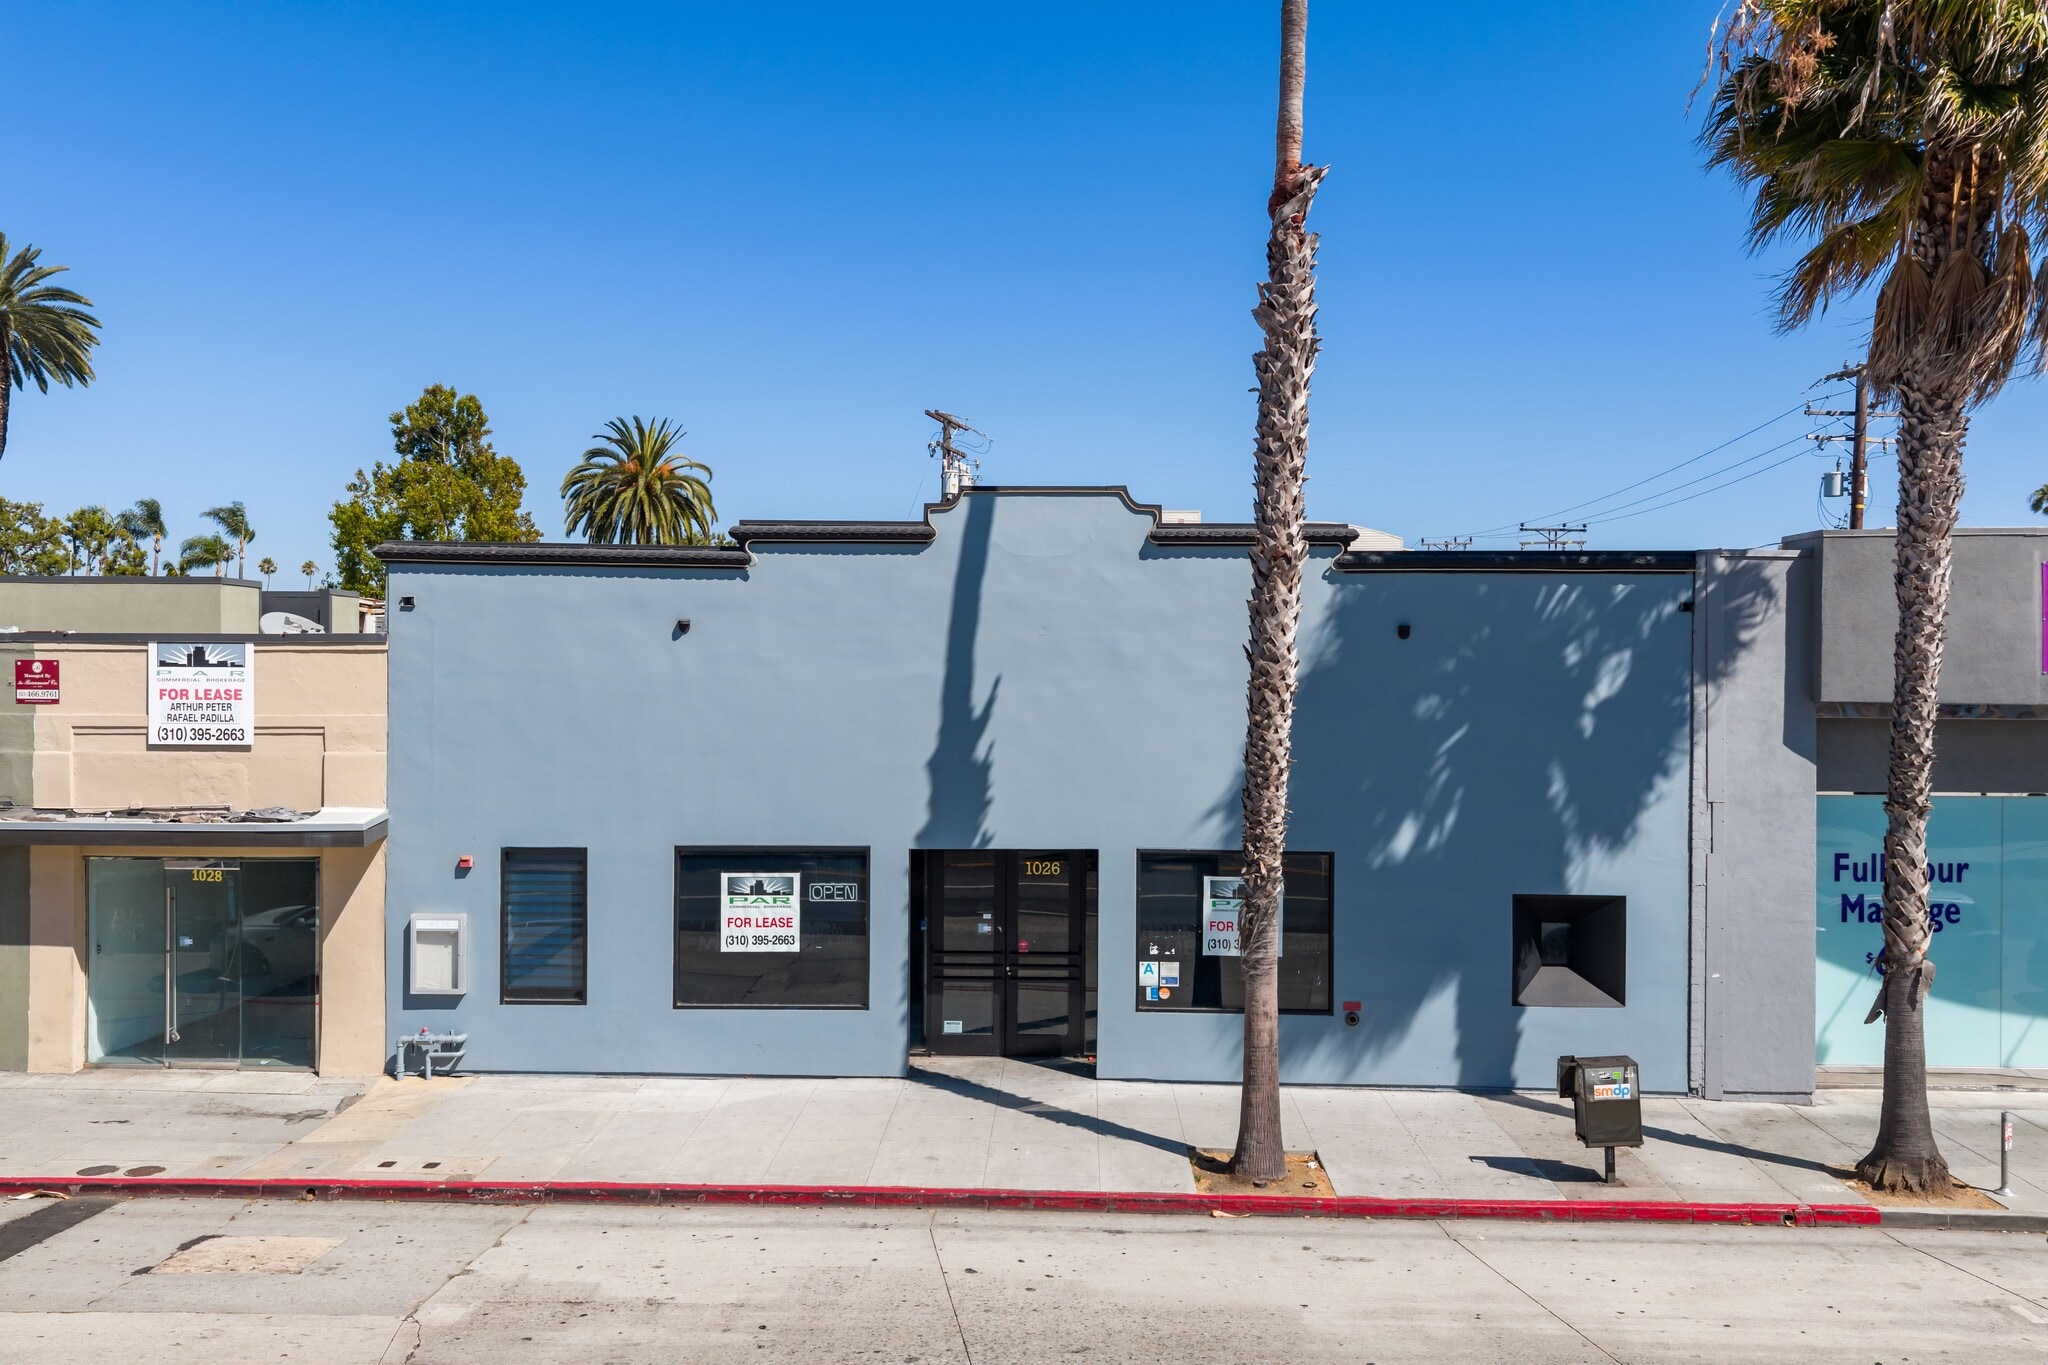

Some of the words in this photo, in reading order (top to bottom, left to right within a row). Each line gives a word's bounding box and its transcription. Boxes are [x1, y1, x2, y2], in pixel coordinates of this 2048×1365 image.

[159, 689, 189, 700] FOR
[195, 689, 242, 700] LEASE
[170, 703, 204, 711] ARTHUR
[206, 703, 232, 711] PETER
[167, 714, 198, 722] RAFAEL
[201, 714, 234, 722] PADILLA
[158, 726, 187, 742] (310)
[190, 728, 244, 741] 395-2663
[1026, 861, 1060, 875] 1026
[192, 869, 223, 882] 1028
[812, 886, 854, 899] OPEN
[728, 917, 752, 928] FOR
[755, 917, 793, 928] LEASE
[1209, 921, 1234, 931] FOR
[725, 935, 748, 948] (310)
[752, 935, 795, 945] 395-2663
[1208, 939, 1231, 951] (310)
[1144, 963, 1154, 975] A
[1595, 1084, 1630, 1098] smdp
